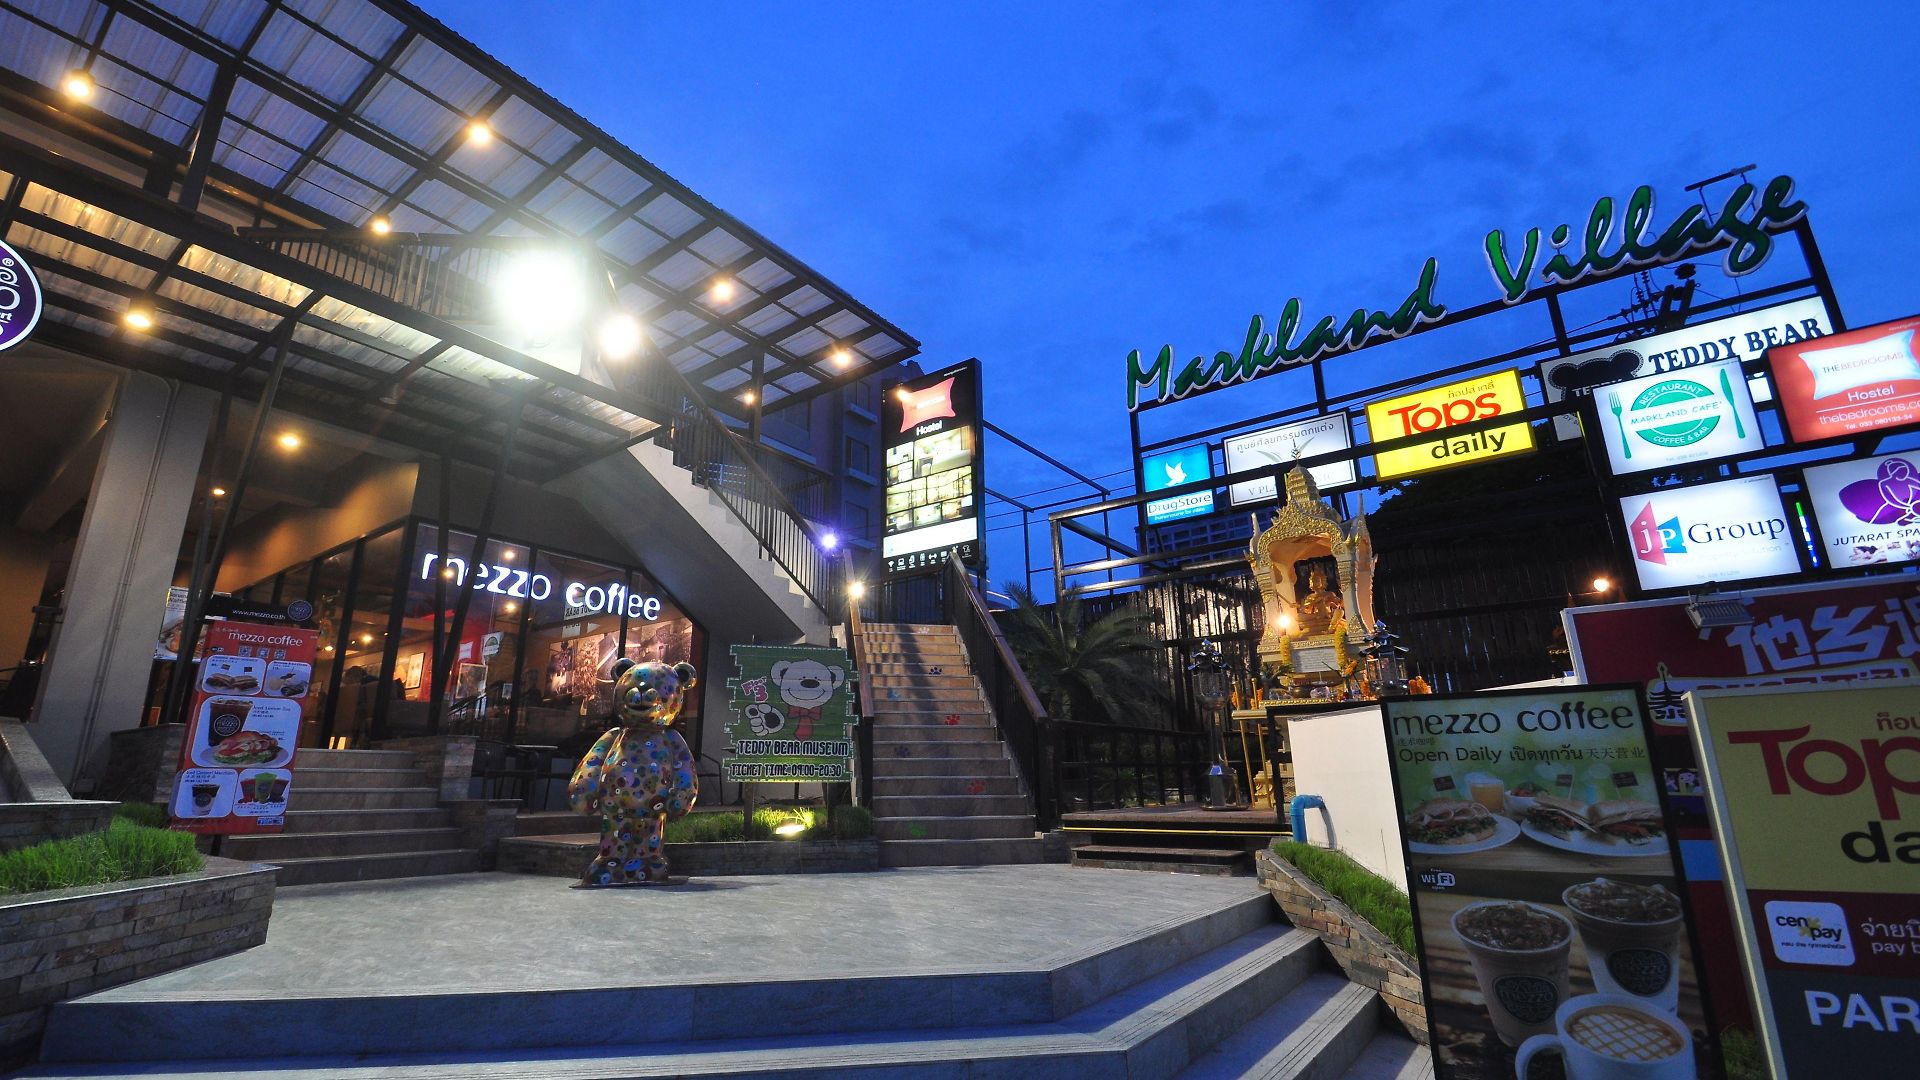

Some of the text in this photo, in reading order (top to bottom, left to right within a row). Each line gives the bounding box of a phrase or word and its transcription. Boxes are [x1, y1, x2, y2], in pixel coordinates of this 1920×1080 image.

[1127, 174, 1808, 411] Markland Village
[1648, 317, 1826, 374] TEDDY BEAR
[1640, 382, 1704, 406] RESTAURANT
[1848, 385, 1895, 402] Hostel
[1388, 392, 1502, 436] Tops
[1630, 408, 1688, 425] MARKLAND
[916, 420, 943, 437] Hostel
[1653, 434, 1686, 445] COFFEE
[1695, 426, 1711, 439] BAR
[1431, 432, 1506, 467] daily
[1148, 494, 1211, 514] DrugStore
[1688, 517, 1785, 545] Group
[1833, 531, 1892, 546] JUTARAT
[421, 552, 661, 621] mezzo coffee
[228, 631, 304, 647] mezzo coffee
[753, 684, 769, 703] 3
[1393, 701, 1635, 736] mezzo coffee
[738, 740, 849, 757] TEDDY BEAR MUSEUM
[1399, 748, 1449, 765] Open
[1456, 747, 1502, 764] Daily
[1510, 743, 1584, 766] เปิดทุกวัน
[730, 763, 764, 777] TICKET
[1727, 724, 1920, 820] Top
[1841, 821, 1920, 864] da
[1776, 916, 1842, 942] cen pay
[1872, 942, 1905, 956] pay
[1804, 990, 1920, 1034] PAR
